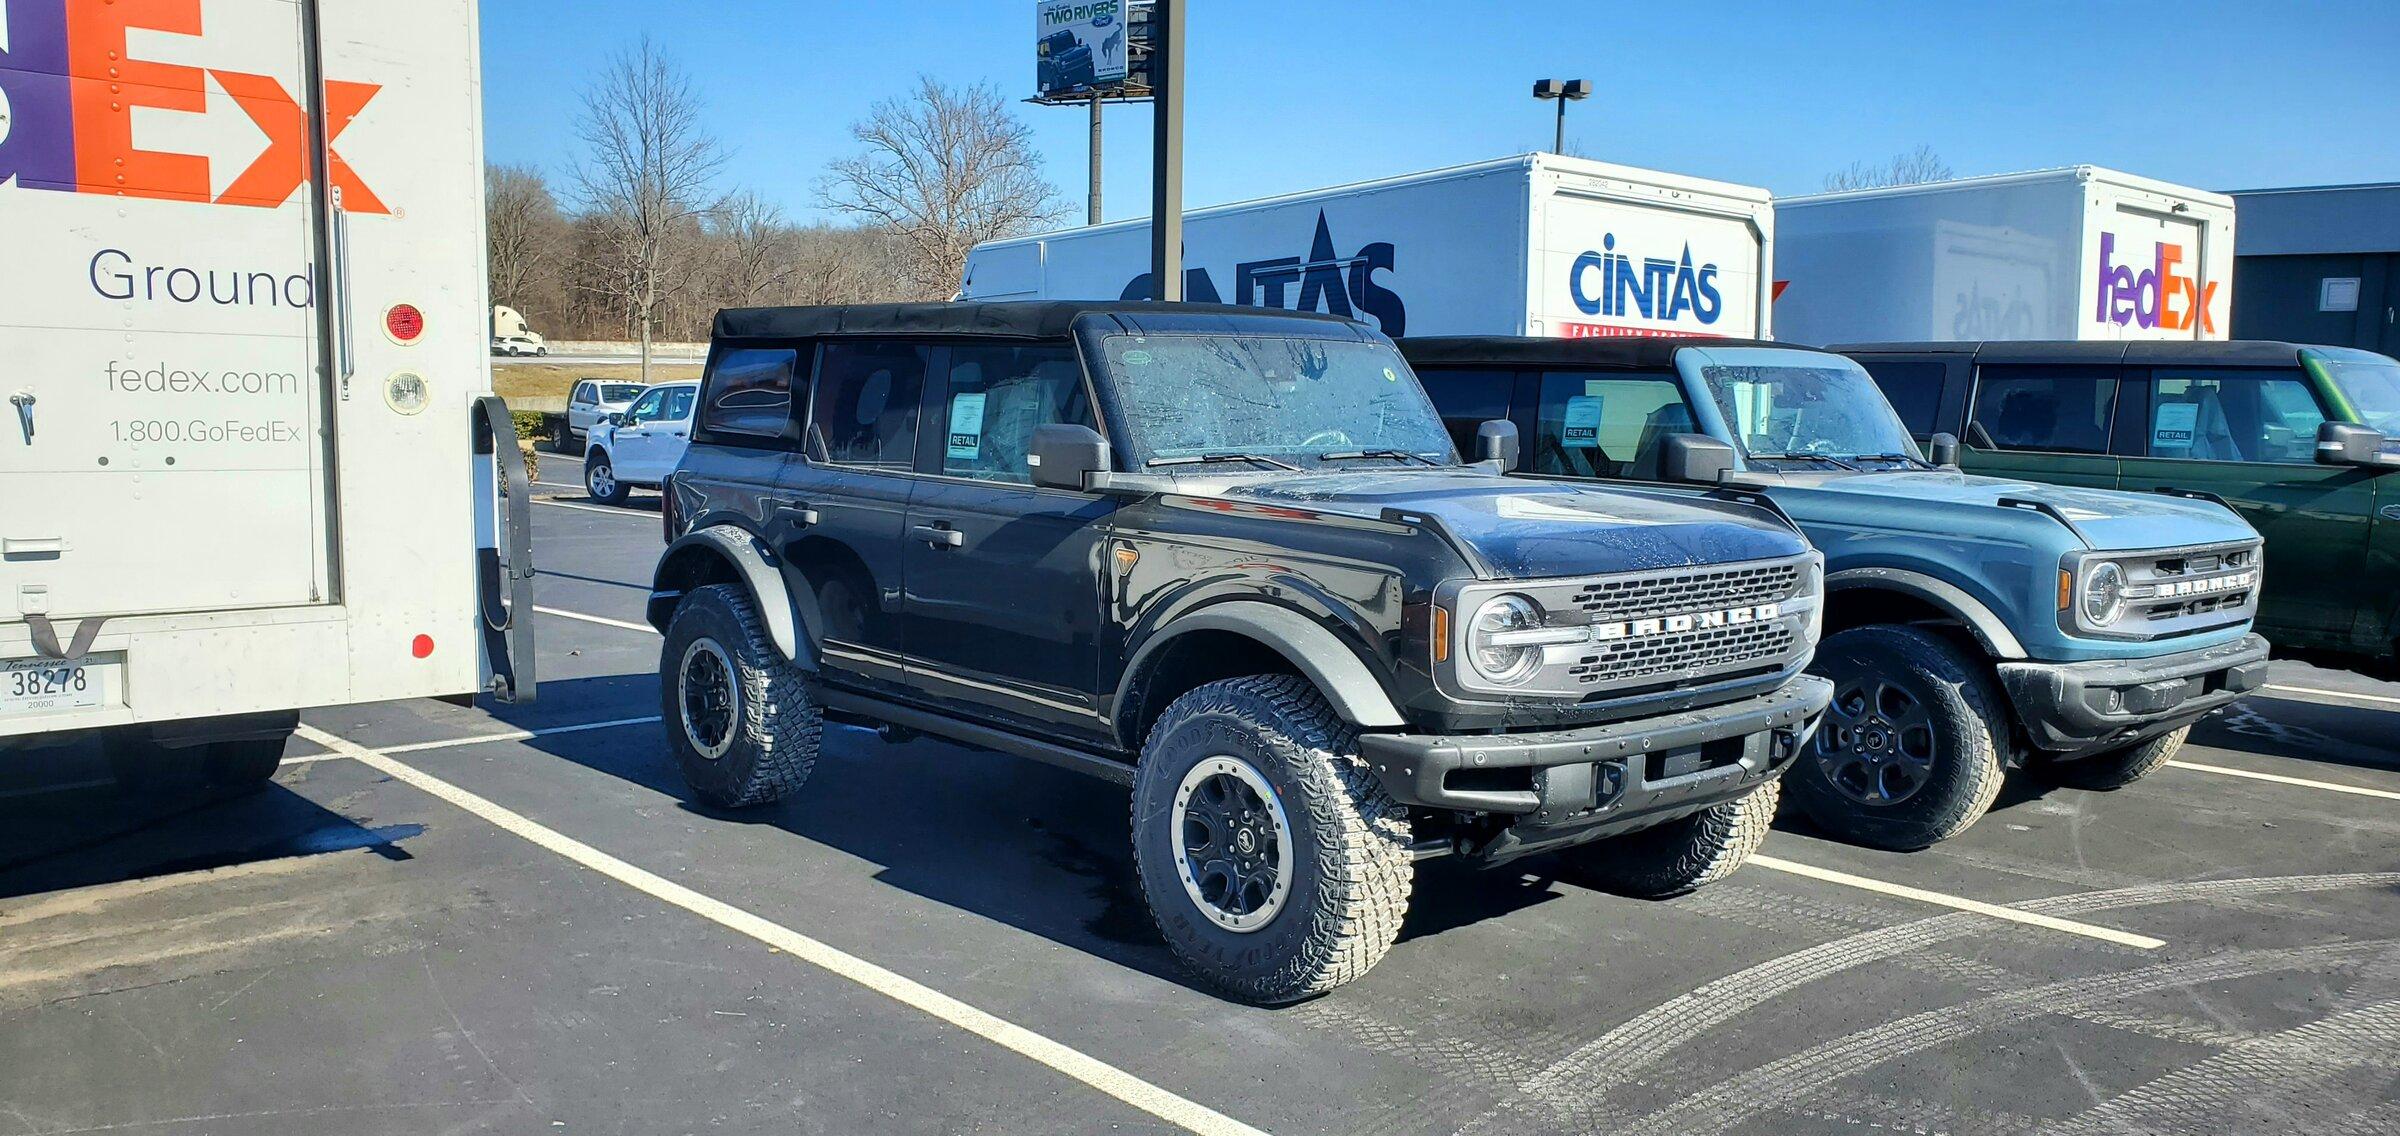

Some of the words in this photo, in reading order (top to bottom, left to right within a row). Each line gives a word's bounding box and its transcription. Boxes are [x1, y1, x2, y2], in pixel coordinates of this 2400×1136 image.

[1043, 9, 1072, 26] TWO
[1074, 0, 1119, 20] RIVERS
[89, 248, 314, 308] Ground
[104, 361, 298, 394] fedex.com
[109, 419, 301, 442] 1.800.GoFedEx
[952, 435, 977, 446] RETAIL
[1567, 429, 1594, 437] RETAIL
[2159, 431, 2188, 439] RETAIL
[2154, 573, 2252, 598] BRONCO
[1598, 603, 1778, 641] BRONCO
[5, 660, 68, 671] Tennessee
[11, 667, 87, 696] 38278
[28, 700, 54, 709] 20000
